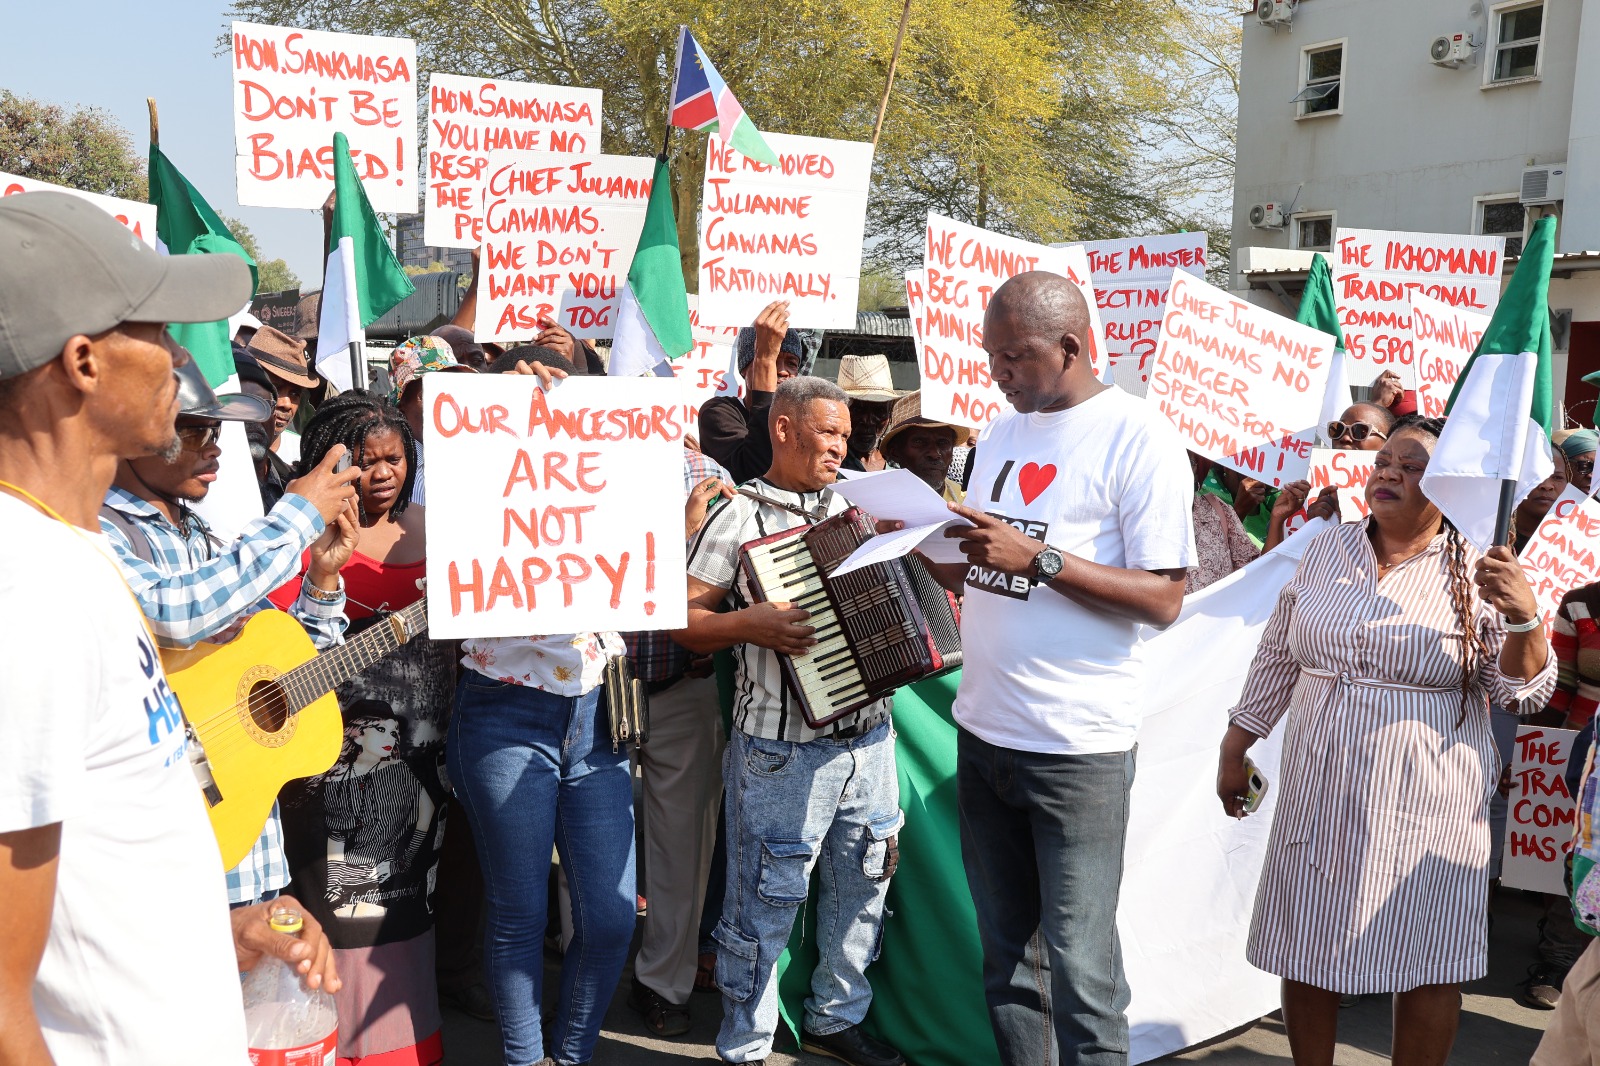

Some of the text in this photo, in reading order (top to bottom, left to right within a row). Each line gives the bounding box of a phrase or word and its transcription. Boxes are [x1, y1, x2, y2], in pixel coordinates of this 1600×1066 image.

[284, 33, 411, 85] SANKWASA
[238, 79, 402, 128] DON'T BE
[478, 83, 594, 127] SANKWASA
[432, 118, 587, 153] YOU HAVE NO
[709, 138, 738, 174] WE
[430, 181, 473, 211] THE
[489, 162, 565, 197] CHIEF
[707, 178, 813, 219] JULIANNE
[486, 198, 605, 235] GAWANAS.
[705, 217, 818, 256] GAWANAS
[486, 240, 620, 270] WE DON'T
[928, 225, 958, 270] WE
[960, 239, 1039, 279] CANNOT
[1087, 244, 1206, 274] THE MINISTER
[1337, 236, 1498, 277] THE IKHOMANI
[488, 272, 616, 301] WANT YOU
[702, 256, 837, 303] TRATIONALLY.
[926, 268, 995, 311] BEG T
[565, 305, 619, 329] TOG
[1172, 279, 1324, 370] CHIEF JULIANNE
[1413, 306, 1456, 349] DOWN
[924, 344, 993, 388] DO HIS
[1165, 310, 1310, 393] GAWANAS NO
[1157, 340, 1250, 407] LONGER
[433, 386, 683, 443] OUR ANCESTORS
[1151, 371, 1313, 459] SPEAKS FOR THE
[503, 448, 607, 498] ARE
[503, 504, 597, 550] NOT
[448, 531, 657, 618] HAPPY!
[1524, 541, 1596, 590] LONGE
[1515, 730, 1567, 766] THE
[1515, 767, 1570, 799] TRA
[1513, 799, 1577, 828] COM
[1510, 831, 1557, 863] HAS
